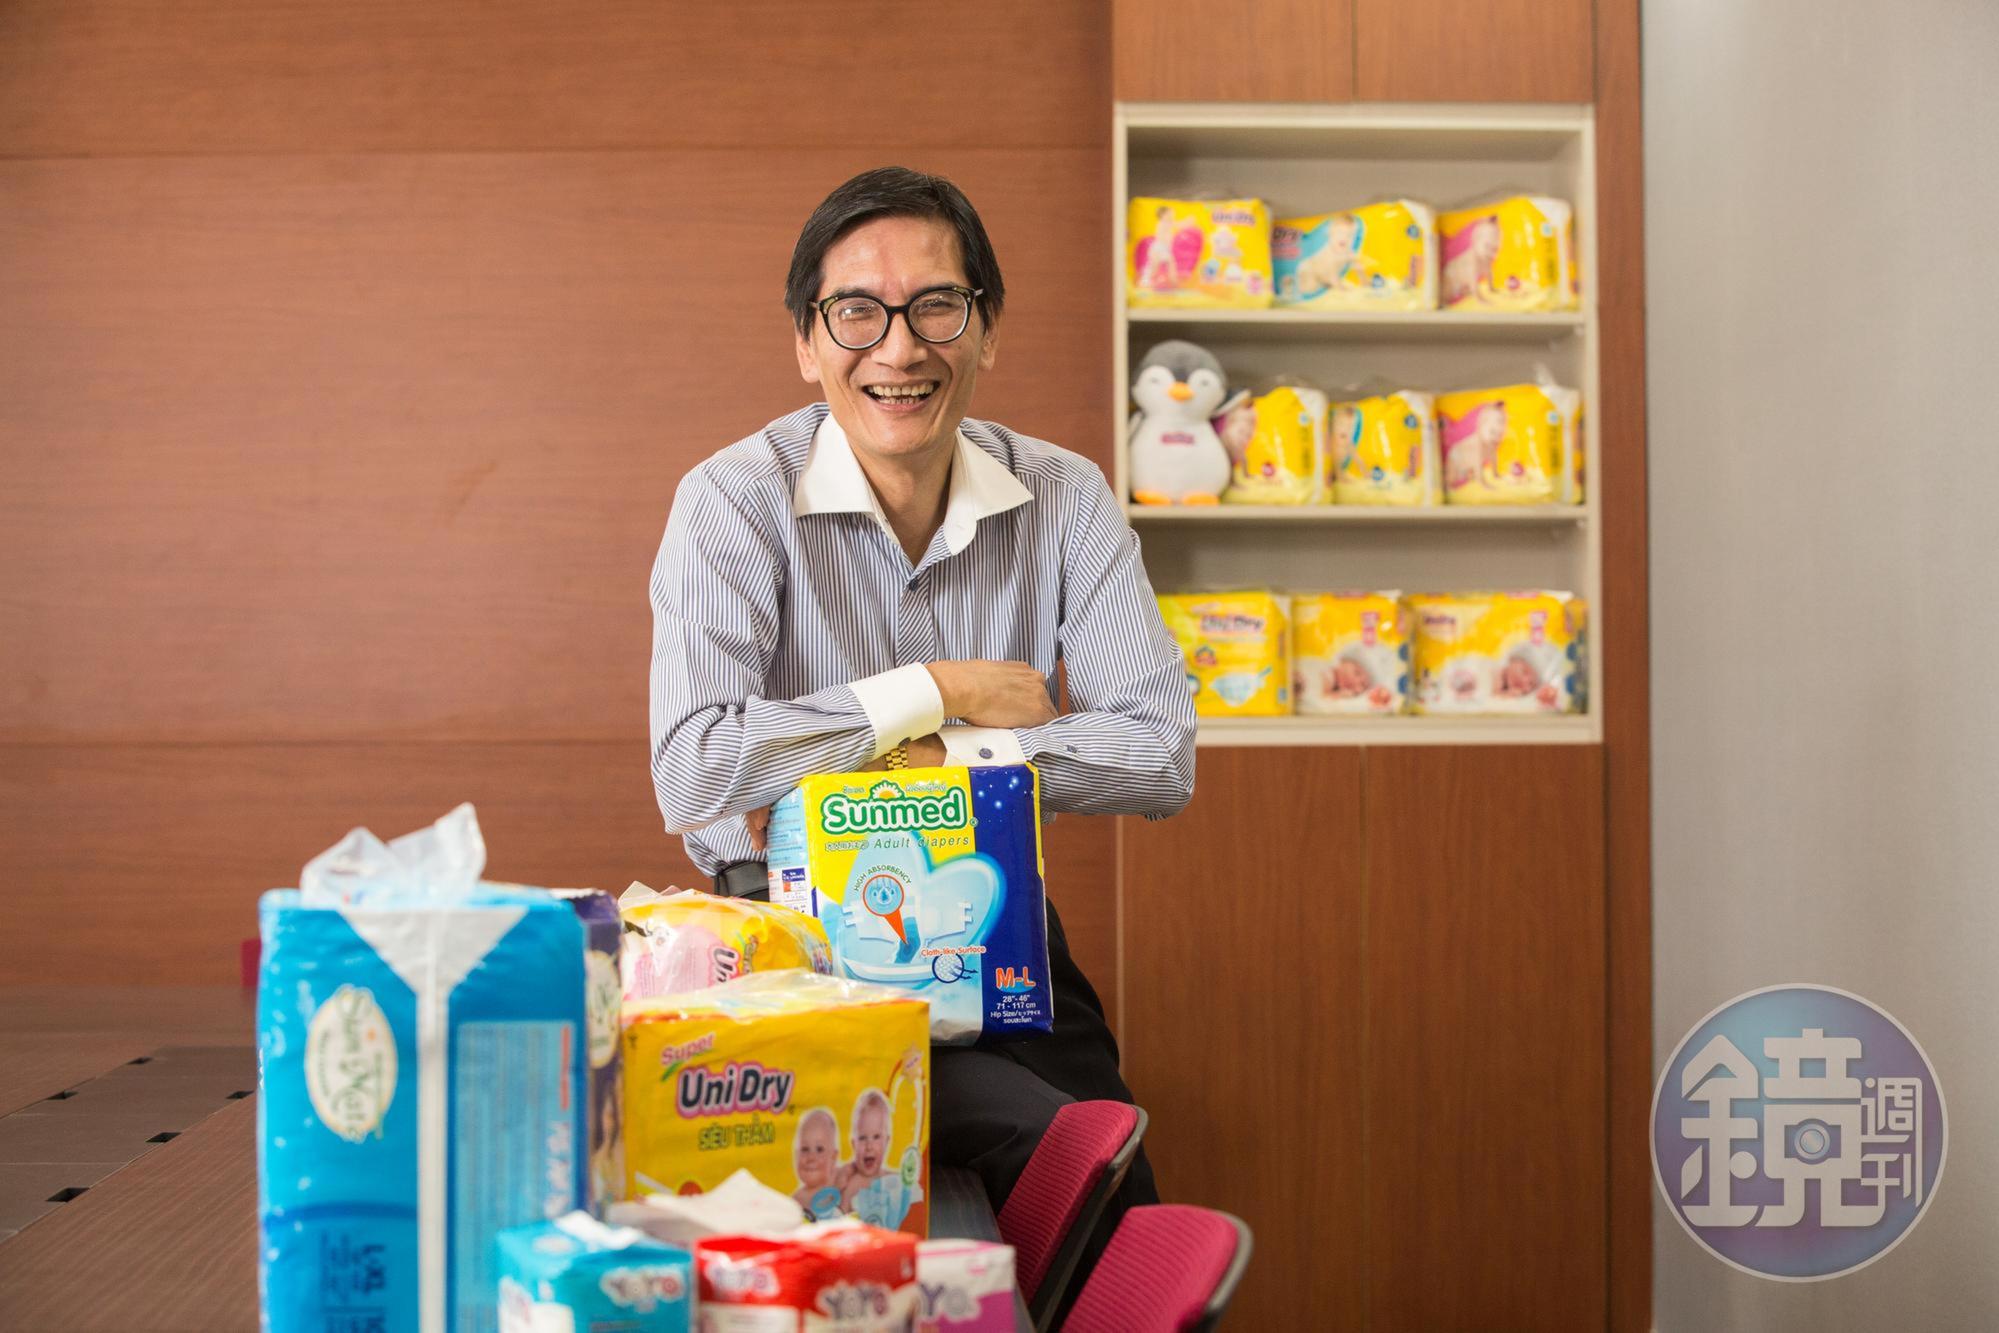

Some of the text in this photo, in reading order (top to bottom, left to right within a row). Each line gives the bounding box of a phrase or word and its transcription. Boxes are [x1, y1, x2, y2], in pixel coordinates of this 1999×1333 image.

[824, 790, 965, 831] Sunmed
[873, 837, 911, 849] Adult
[917, 836, 970, 849] diapers
[854, 864, 912, 892] HIGH ABSORBENCY
[958, 946, 986, 955] Surface
[995, 966, 1037, 989] M-L
[990, 1011, 1002, 1019] Hip
[661, 1032, 716, 1065] Super
